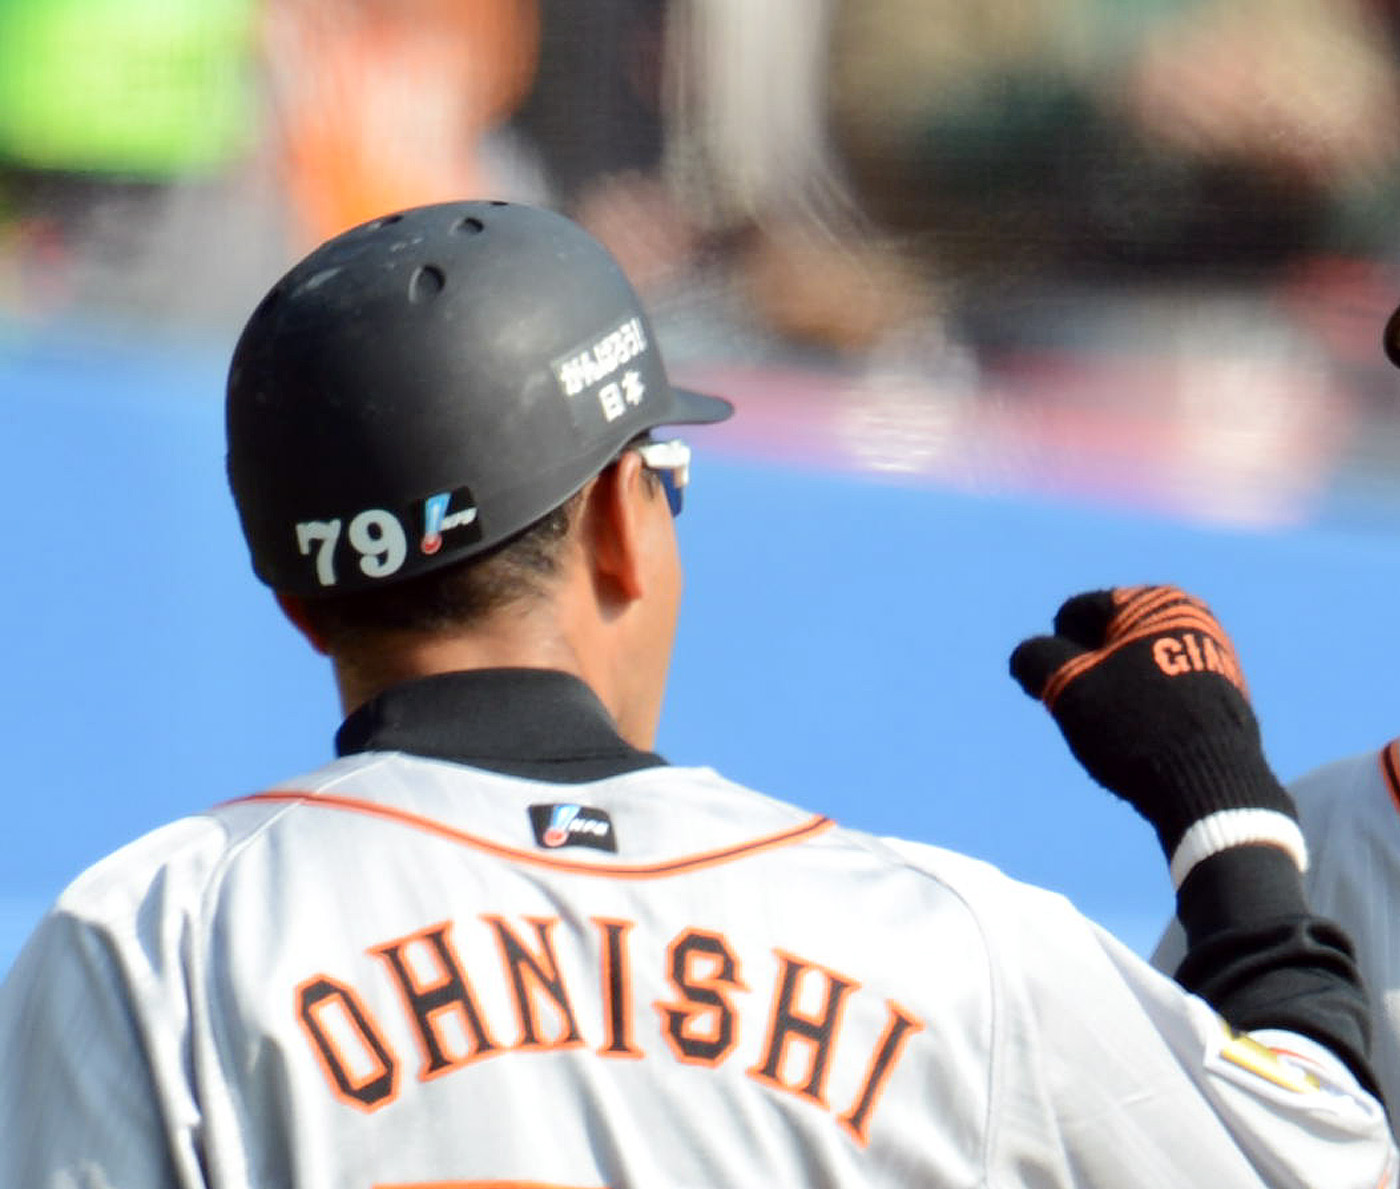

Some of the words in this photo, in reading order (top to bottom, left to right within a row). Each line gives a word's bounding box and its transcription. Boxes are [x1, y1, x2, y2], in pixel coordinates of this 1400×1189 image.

[599, 371, 645, 422] 日本
[296, 508, 407, 587] 79
[294, 912, 926, 1148] OHNISHI
